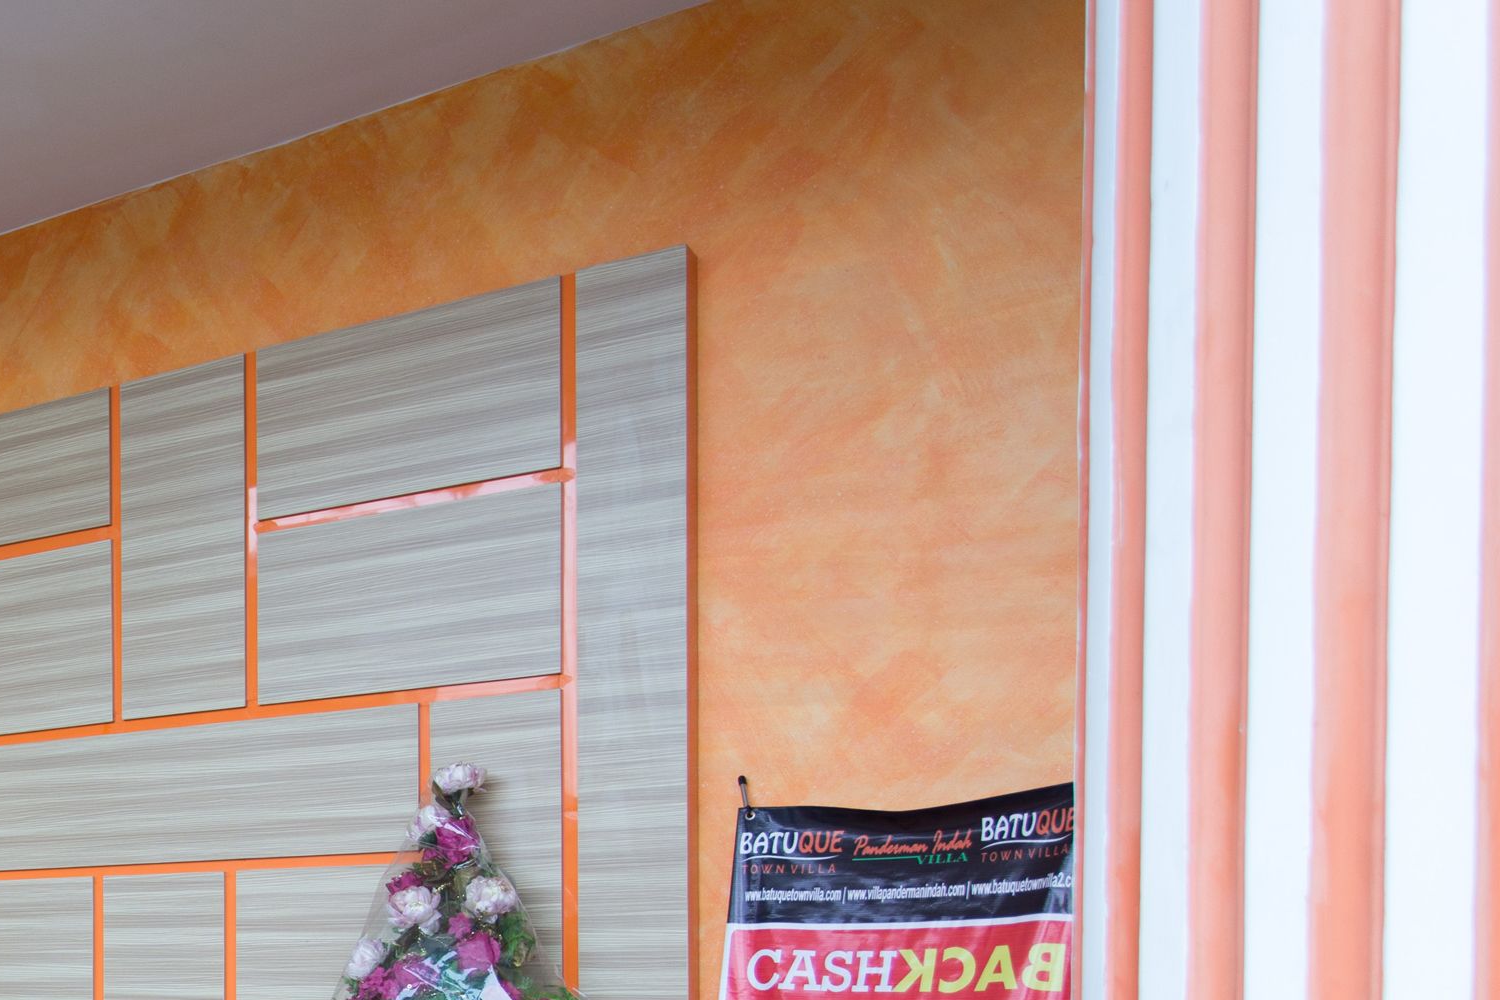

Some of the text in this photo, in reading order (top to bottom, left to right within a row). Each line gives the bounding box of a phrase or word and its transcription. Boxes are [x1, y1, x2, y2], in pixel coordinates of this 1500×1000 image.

[739, 830, 845, 855] BATUQUE
[742, 843, 1069, 875] TOWN VILLA VILLA TOWN VILLA
[744, 872, 1074, 904] www.batuquetownvilla.com www.villapandermanindah.com www.batuquetownvilla2.c
